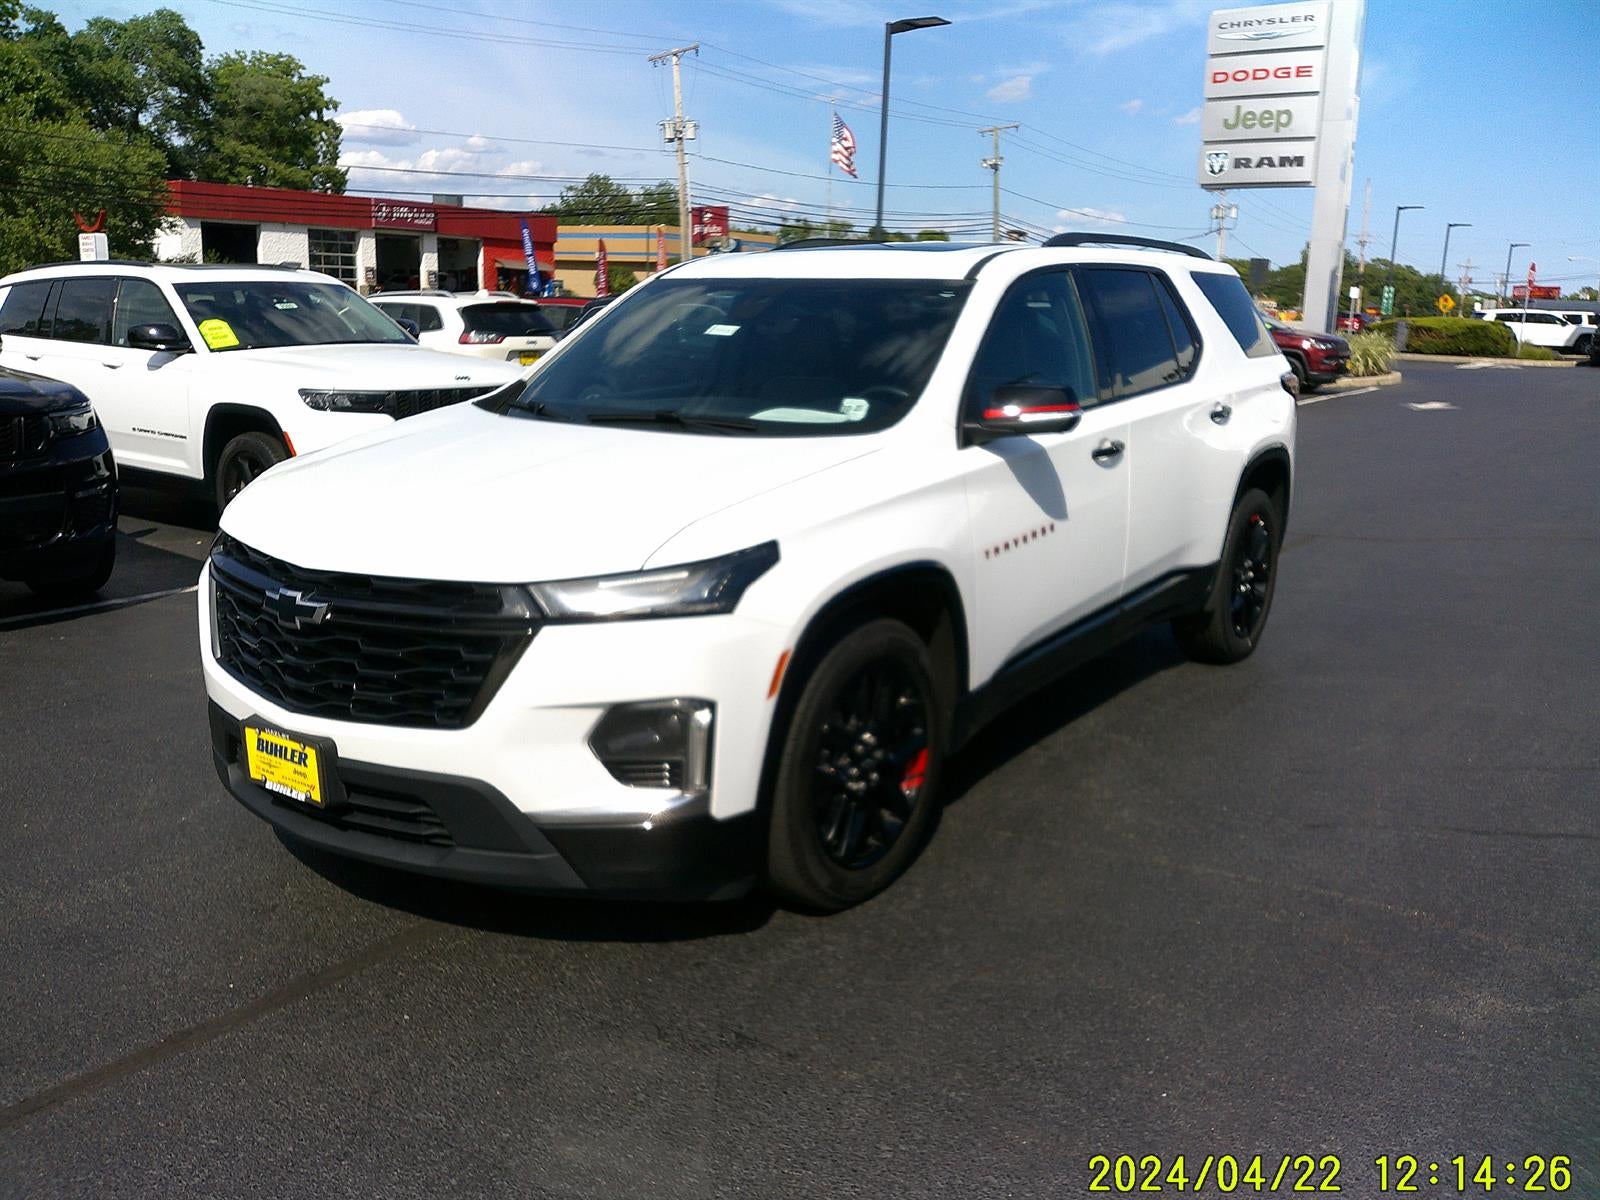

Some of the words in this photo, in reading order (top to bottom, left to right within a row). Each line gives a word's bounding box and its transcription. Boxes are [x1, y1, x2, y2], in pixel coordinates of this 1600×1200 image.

[1218, 14, 1315, 30] CHRYSLER
[1212, 65, 1313, 84] DODGE
[1223, 105, 1293, 132] Jeep
[1234, 155, 1305, 169] RAM
[256, 736, 309, 769] BUHLER
